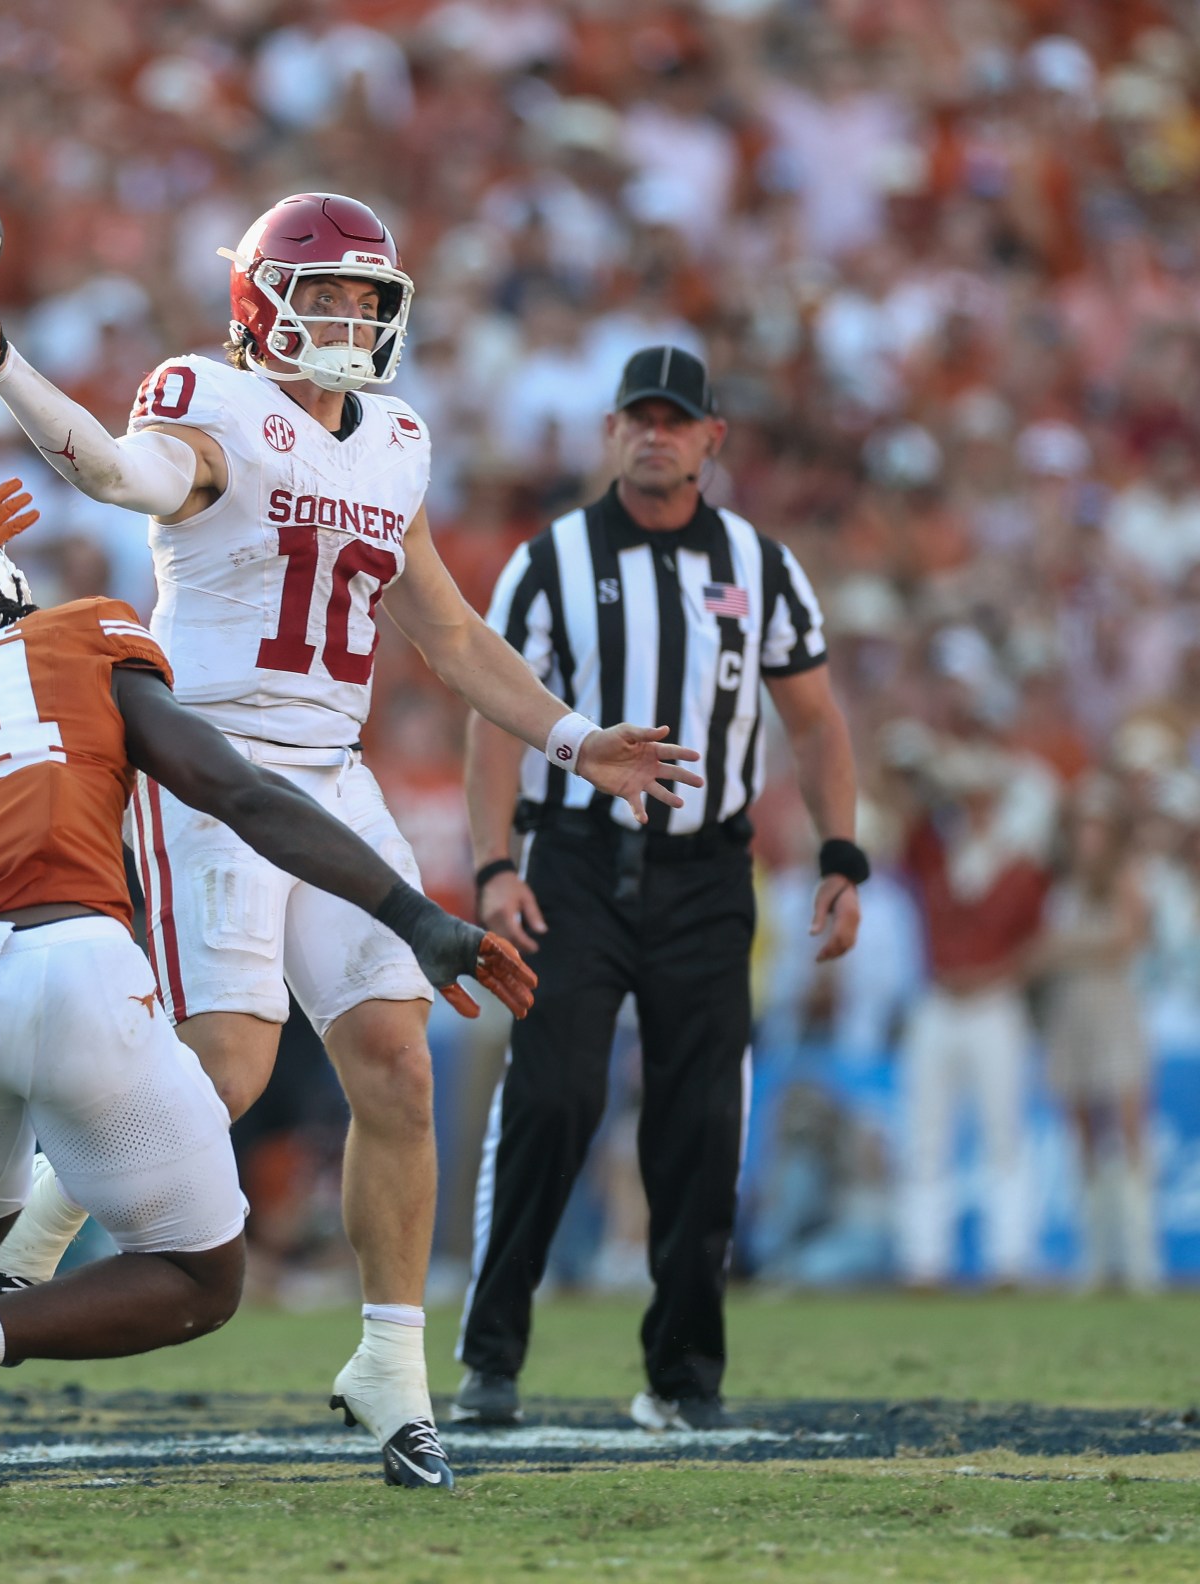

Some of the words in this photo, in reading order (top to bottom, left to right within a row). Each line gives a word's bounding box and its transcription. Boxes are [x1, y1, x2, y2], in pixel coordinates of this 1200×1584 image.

[132, 366, 196, 419] 10
[264, 415, 295, 451] SEC
[268, 488, 404, 546] SOONERS
[255, 525, 397, 685] 10
[719, 649, 742, 691] C
